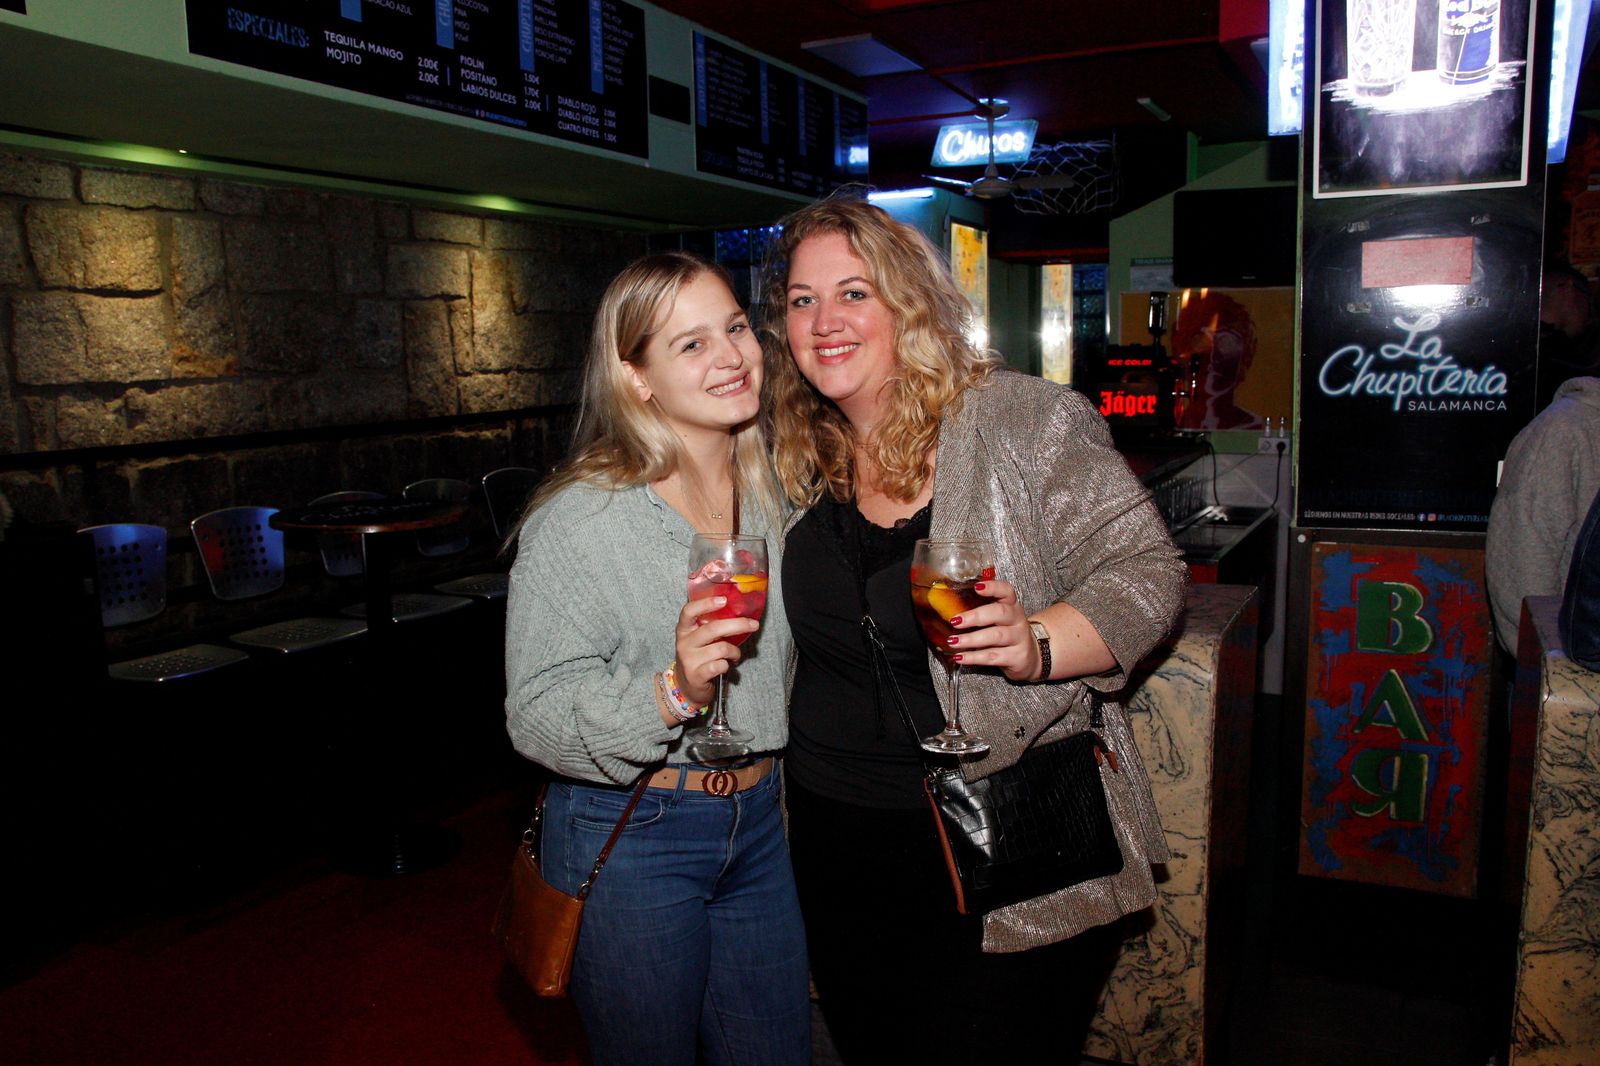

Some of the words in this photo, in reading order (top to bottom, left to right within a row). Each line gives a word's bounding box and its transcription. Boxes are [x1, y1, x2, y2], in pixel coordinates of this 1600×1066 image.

[226, 7, 311, 49] ESPECIALES:
[323, 29, 366, 51] TEQUILA
[367, 41, 404, 61] MANGO
[326, 46, 363, 66] MOJITO
[460, 68, 499, 87] POSITANO
[461, 81, 489, 98] LABIOS
[489, 88, 518, 105] DULCES
[557, 95, 581, 110] DIABLO
[557, 107, 581, 122] DIABLO
[1380, 313, 1443, 361] La
[1318, 345, 1508, 412] Chupitería
[1099, 390, 1158, 417] Jäger
[1408, 399, 1508, 411] SALAMANCA
[1332, 510, 1341, 519] EN
[1341, 511, 1369, 520] NUESTRAS
